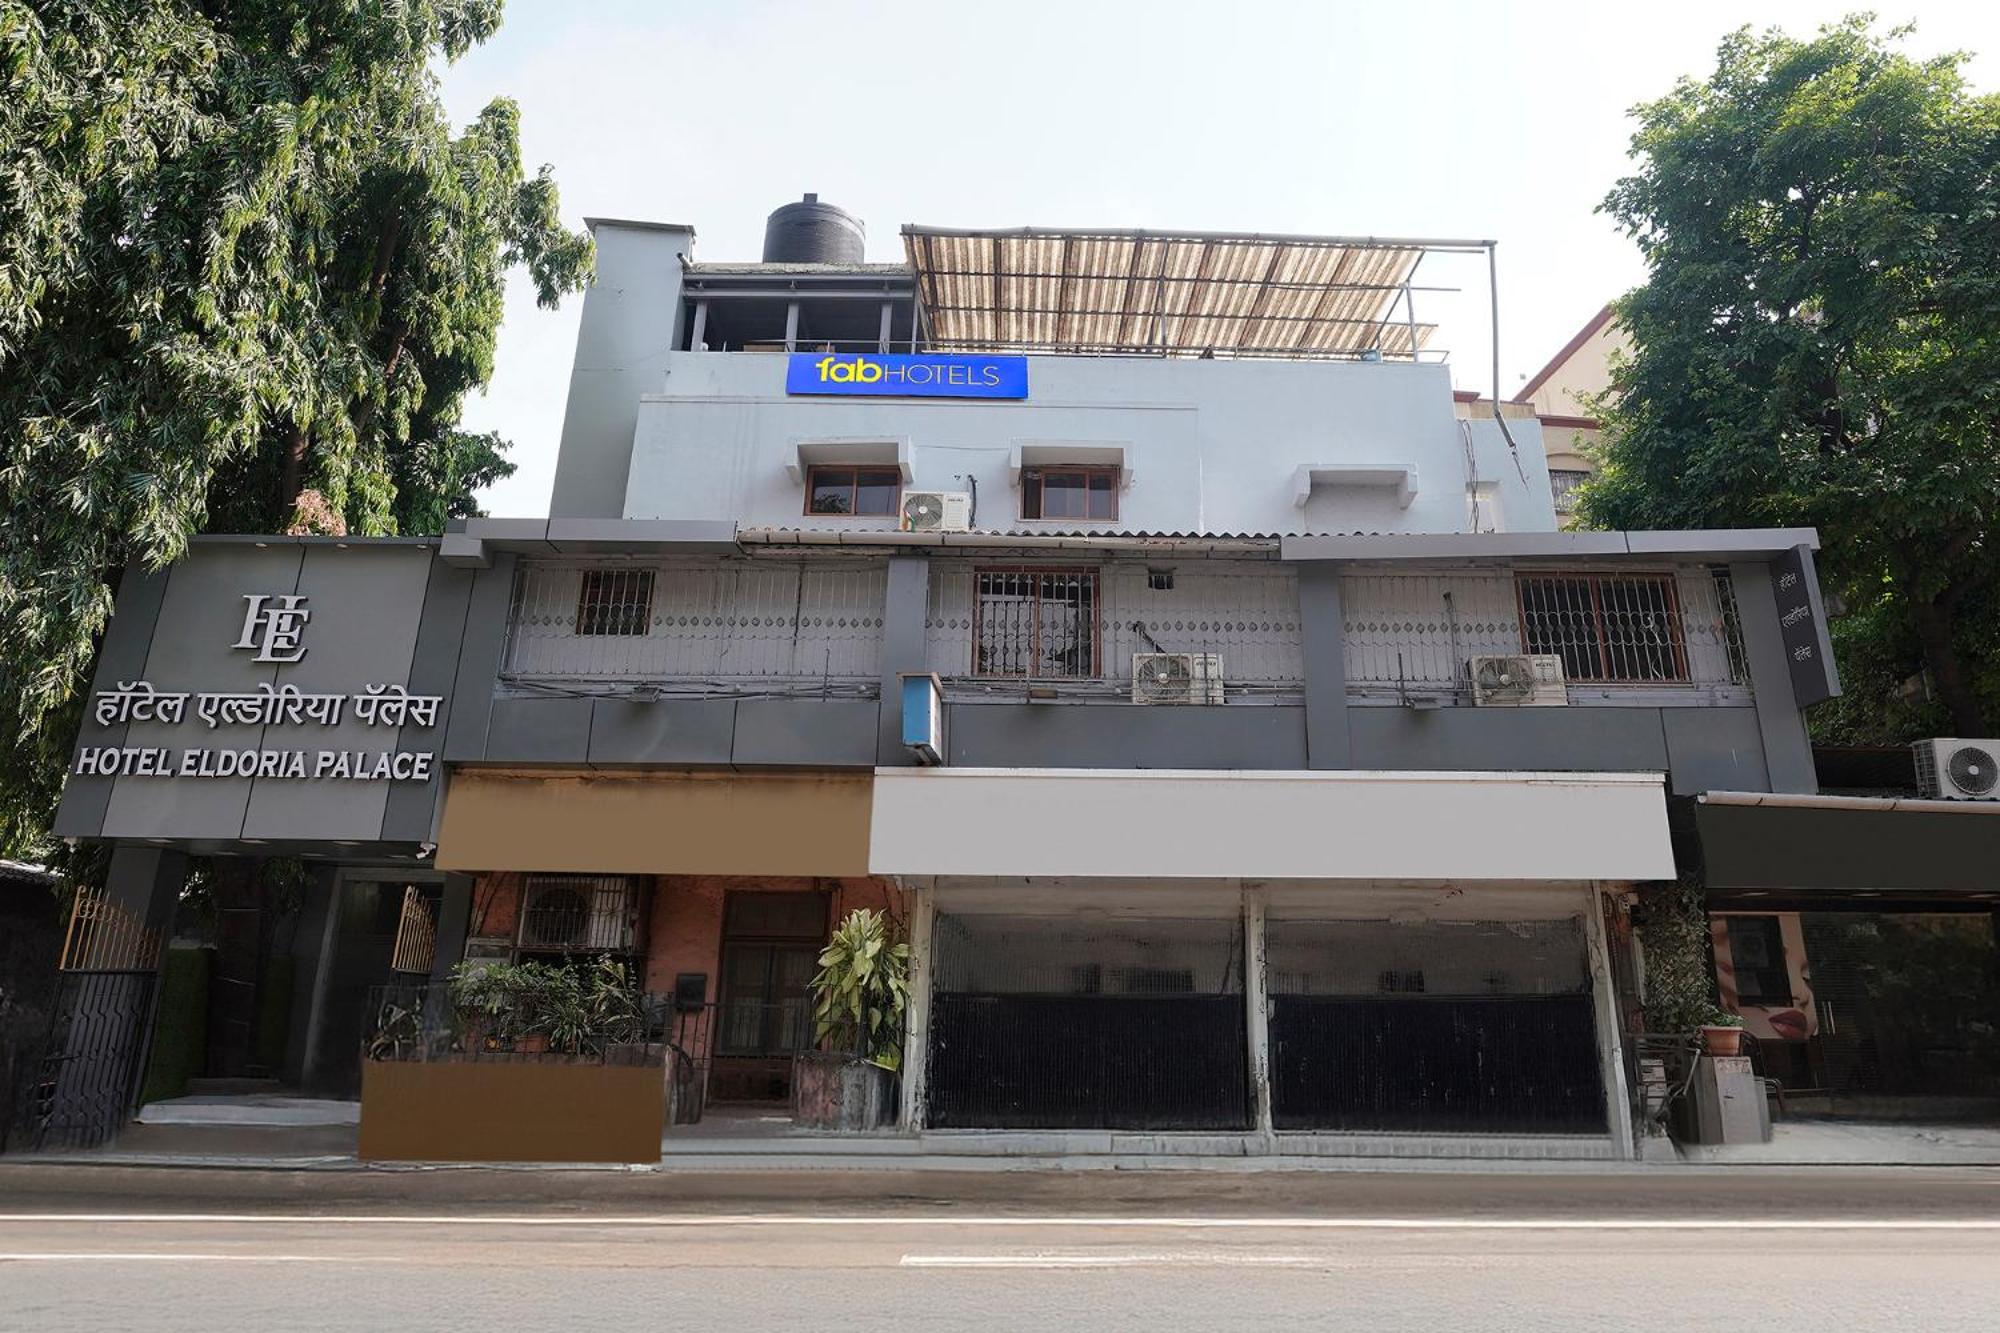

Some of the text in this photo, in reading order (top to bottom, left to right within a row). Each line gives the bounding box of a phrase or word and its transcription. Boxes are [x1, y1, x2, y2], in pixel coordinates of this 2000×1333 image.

[96, 681, 443, 728] हॉटेल एल्डोरिया पॅलेस
[75, 747, 434, 781] HOTEL ELDORIA PALACE
